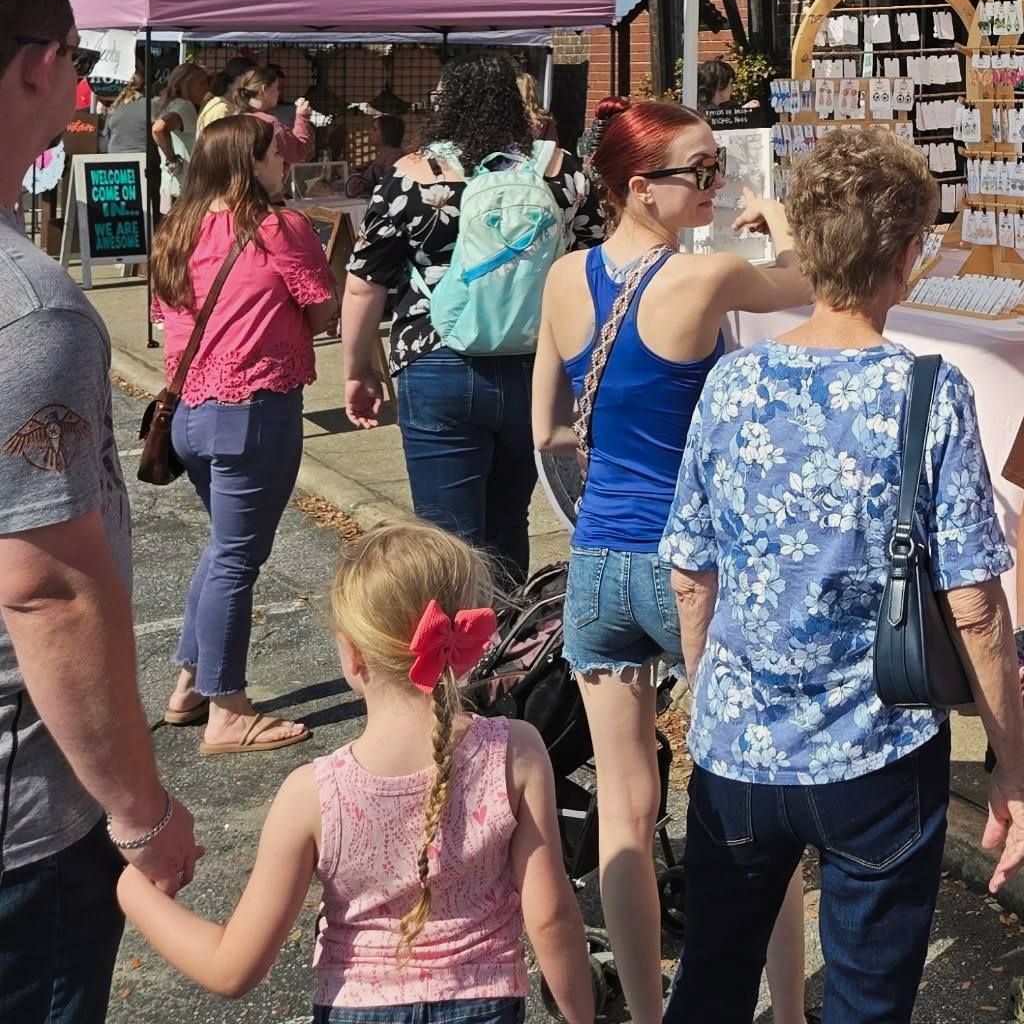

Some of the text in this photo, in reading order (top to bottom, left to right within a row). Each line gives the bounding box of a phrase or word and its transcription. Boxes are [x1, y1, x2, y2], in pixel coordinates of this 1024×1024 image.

[90, 169, 136, 185] WELCOME!
[91, 184, 137, 202] COME ON
[95, 220, 139, 236] WE ARE
[96, 235, 141, 251] AWESOME
